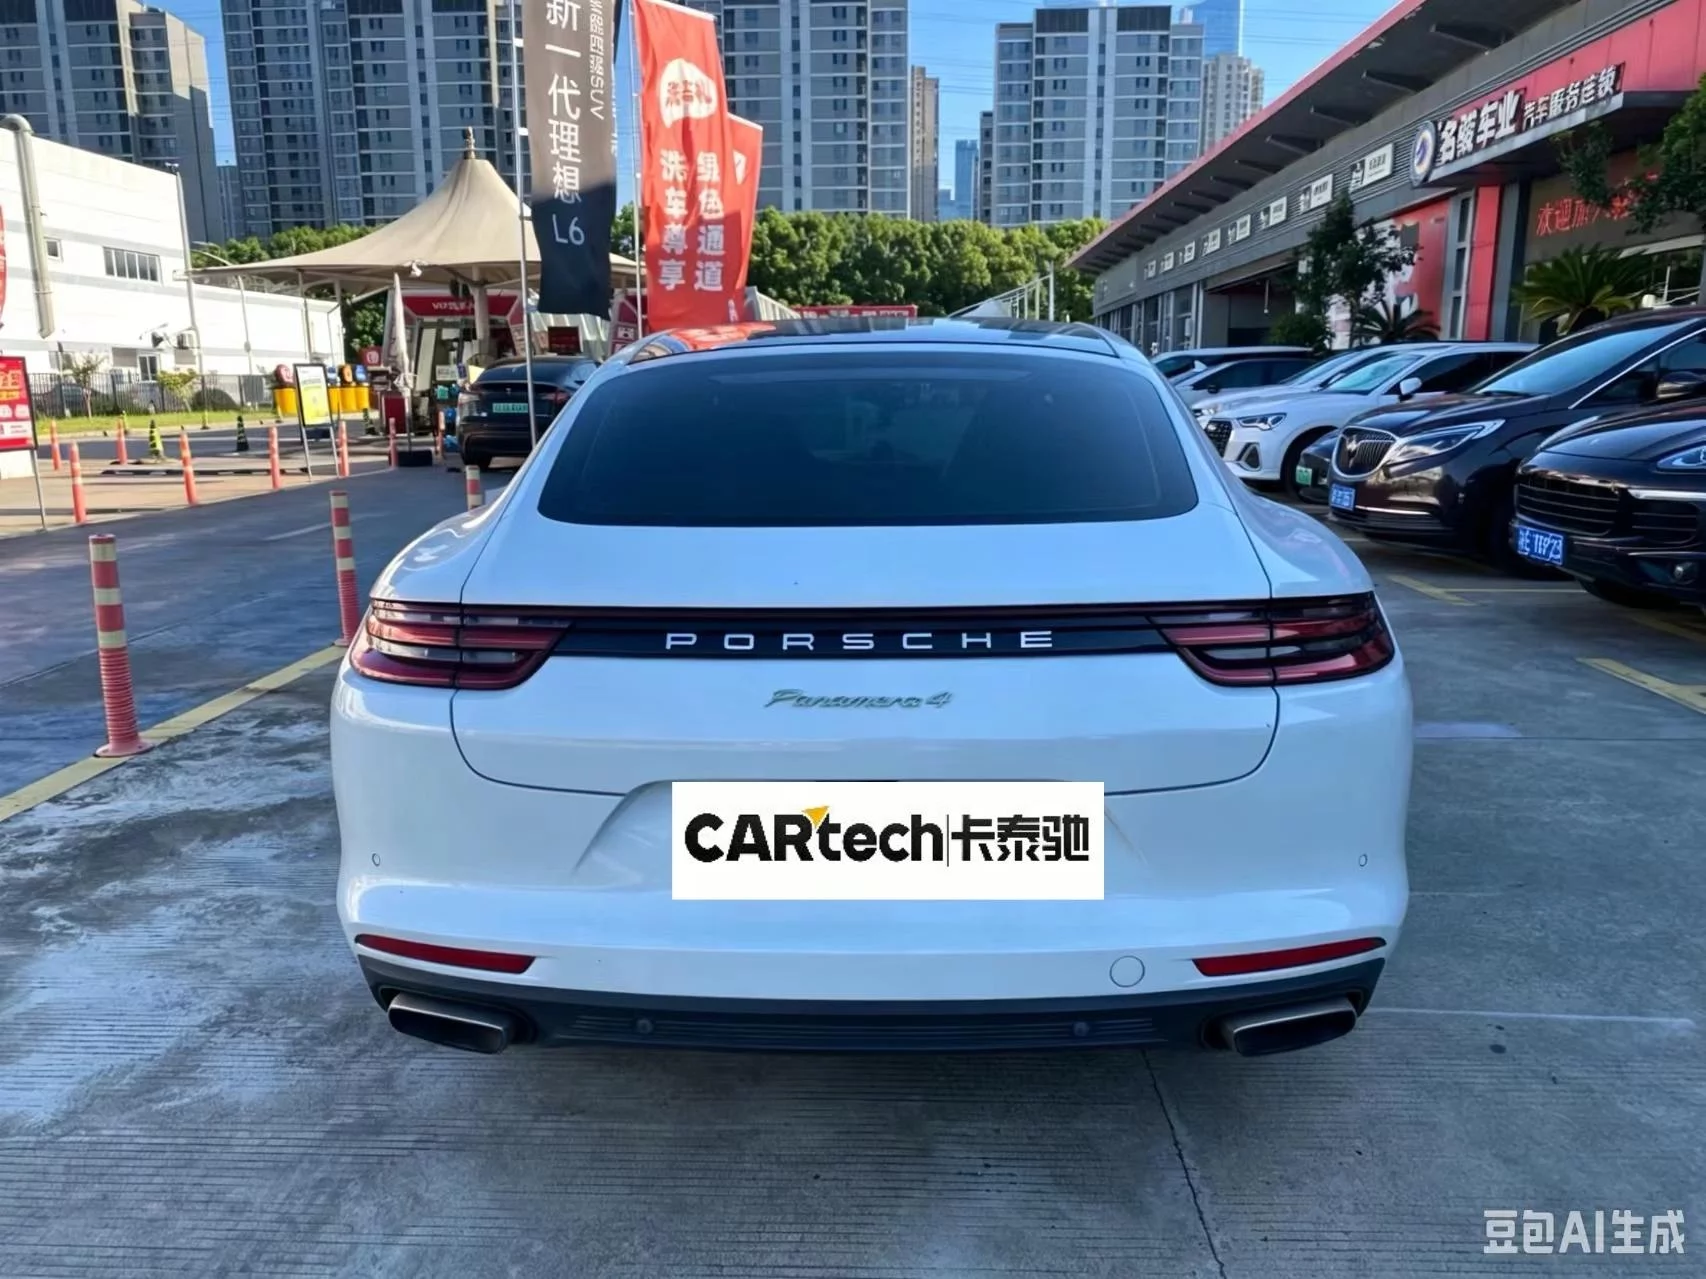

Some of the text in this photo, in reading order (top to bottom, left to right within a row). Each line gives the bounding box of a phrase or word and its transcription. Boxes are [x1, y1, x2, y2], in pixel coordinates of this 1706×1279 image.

[551, 213, 585, 247] L6
[665, 631, 1053, 651] PORSCHE
[763, 688, 922, 709] Panamera
